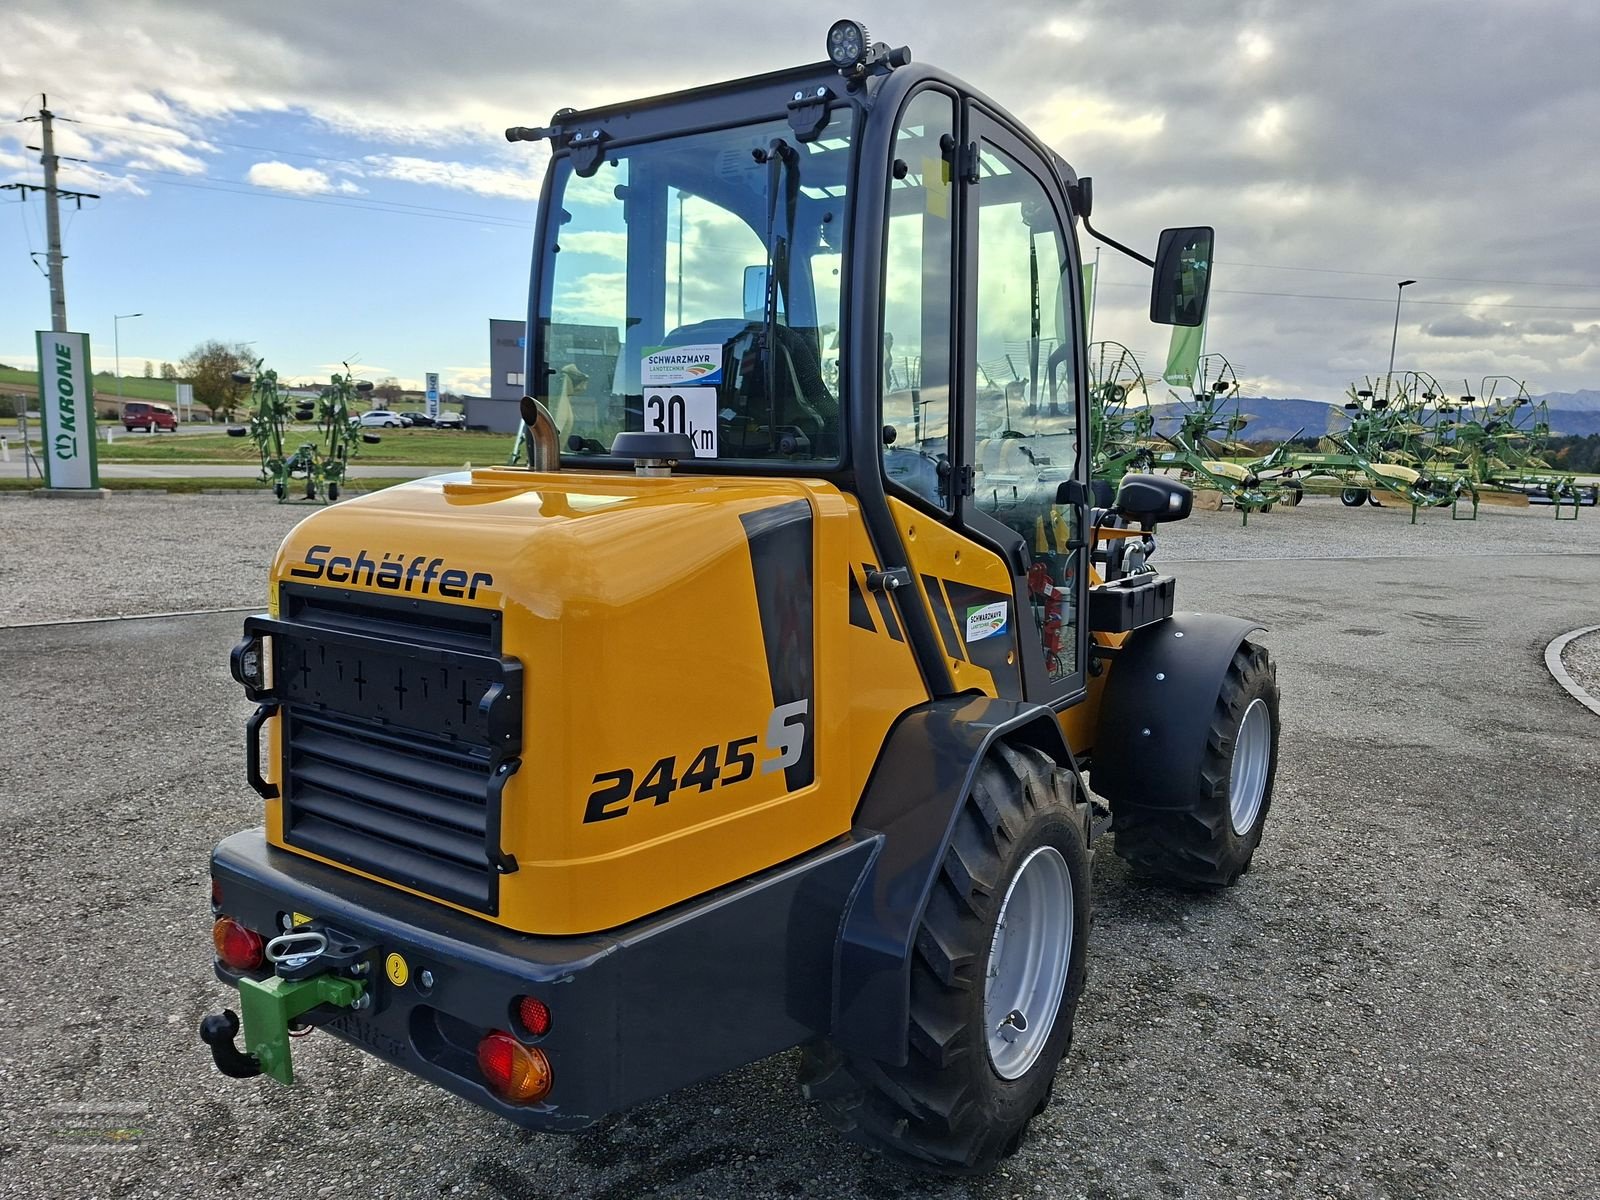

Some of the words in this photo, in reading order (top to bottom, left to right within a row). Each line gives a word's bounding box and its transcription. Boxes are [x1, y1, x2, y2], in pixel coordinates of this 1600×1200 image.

[648, 355, 709, 364] SCHWARZMAYR
[55, 342, 76, 433] KRONE
[648, 395, 686, 434] 30
[689, 421, 713, 449] km
[291, 545, 493, 600] Schäffer
[971, 611, 1001, 623] SCHWARZMAYR
